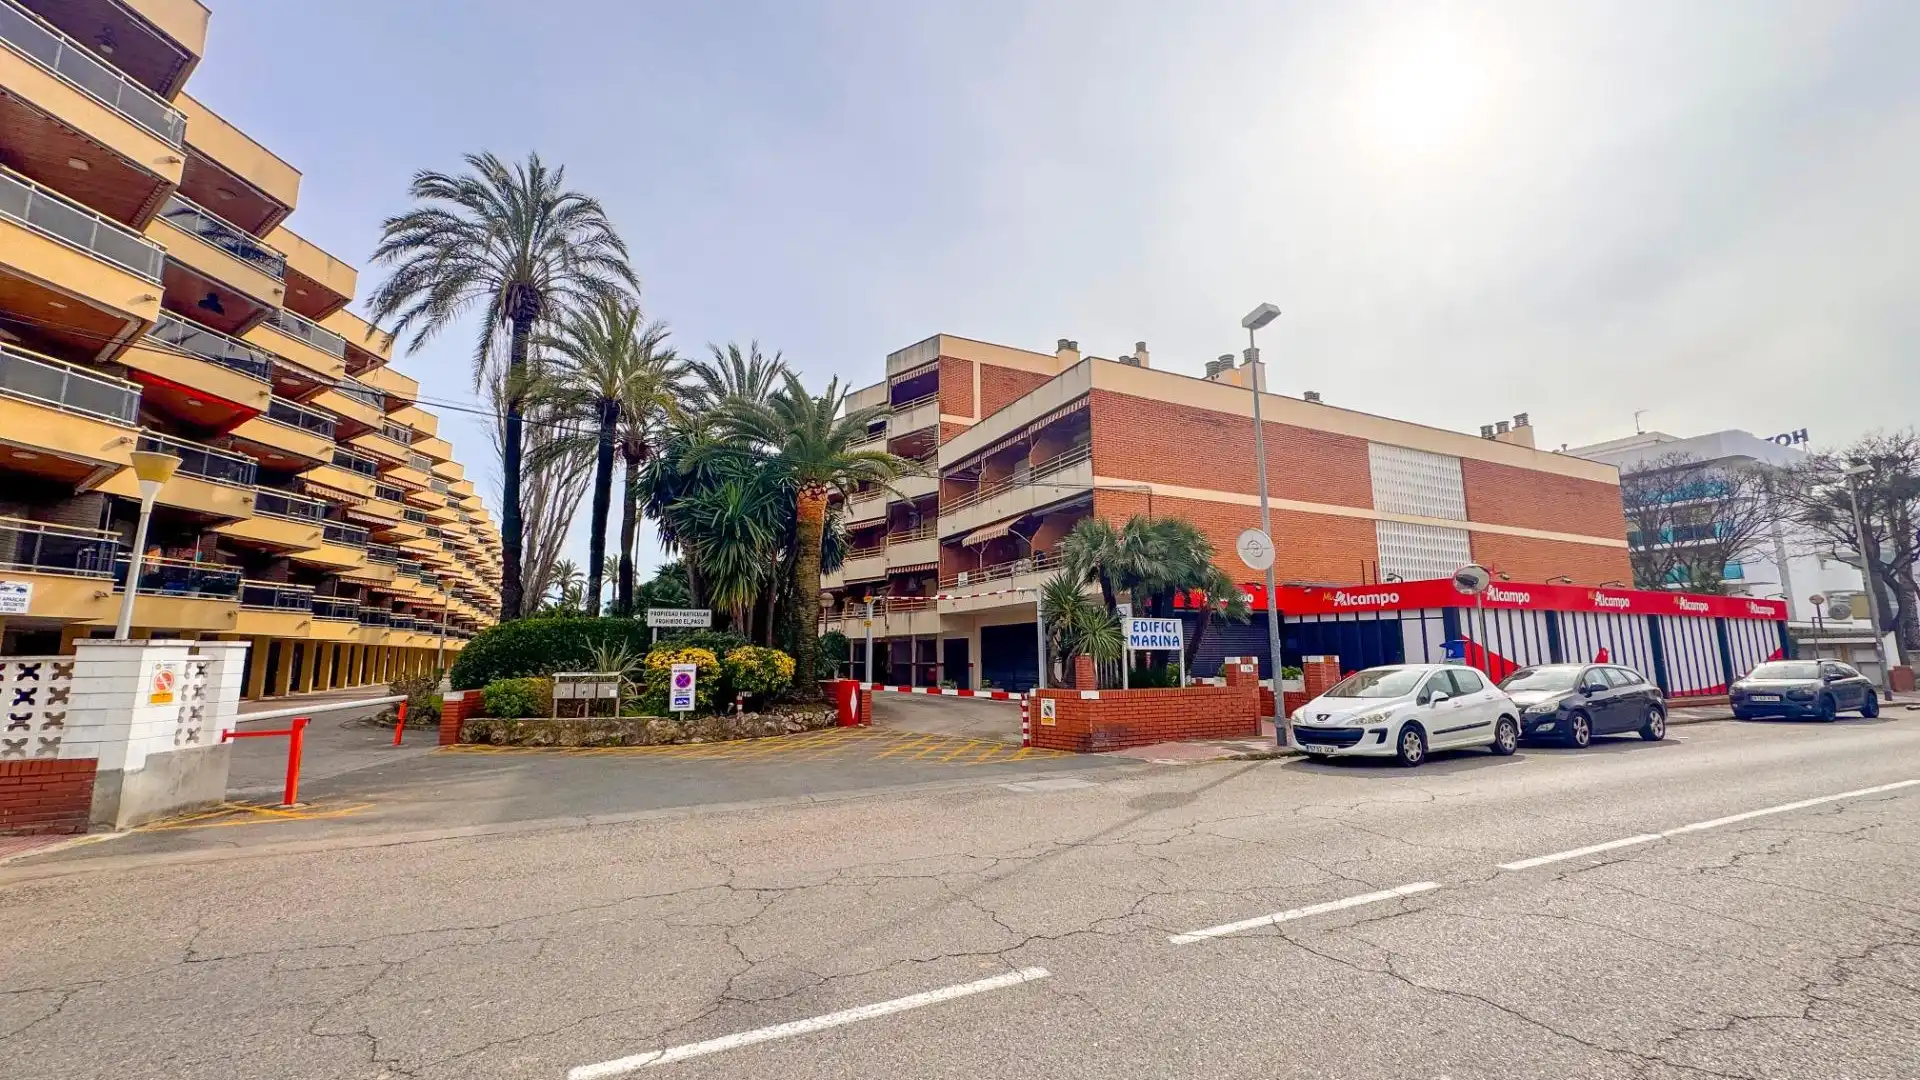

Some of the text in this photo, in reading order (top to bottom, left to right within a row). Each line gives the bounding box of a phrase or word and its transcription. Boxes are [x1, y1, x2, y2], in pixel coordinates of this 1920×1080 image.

[1334, 591, 1400, 607] Alcampo
[1487, 584, 1530, 605] Alcampo
[1594, 591, 1630, 610] Alcampo
[1680, 596, 1709, 613] Alcampo
[1750, 601, 1775, 616] Alcampo
[1132, 621, 1177, 633] EDIFICI
[1130, 634, 1181, 647] MARINA
